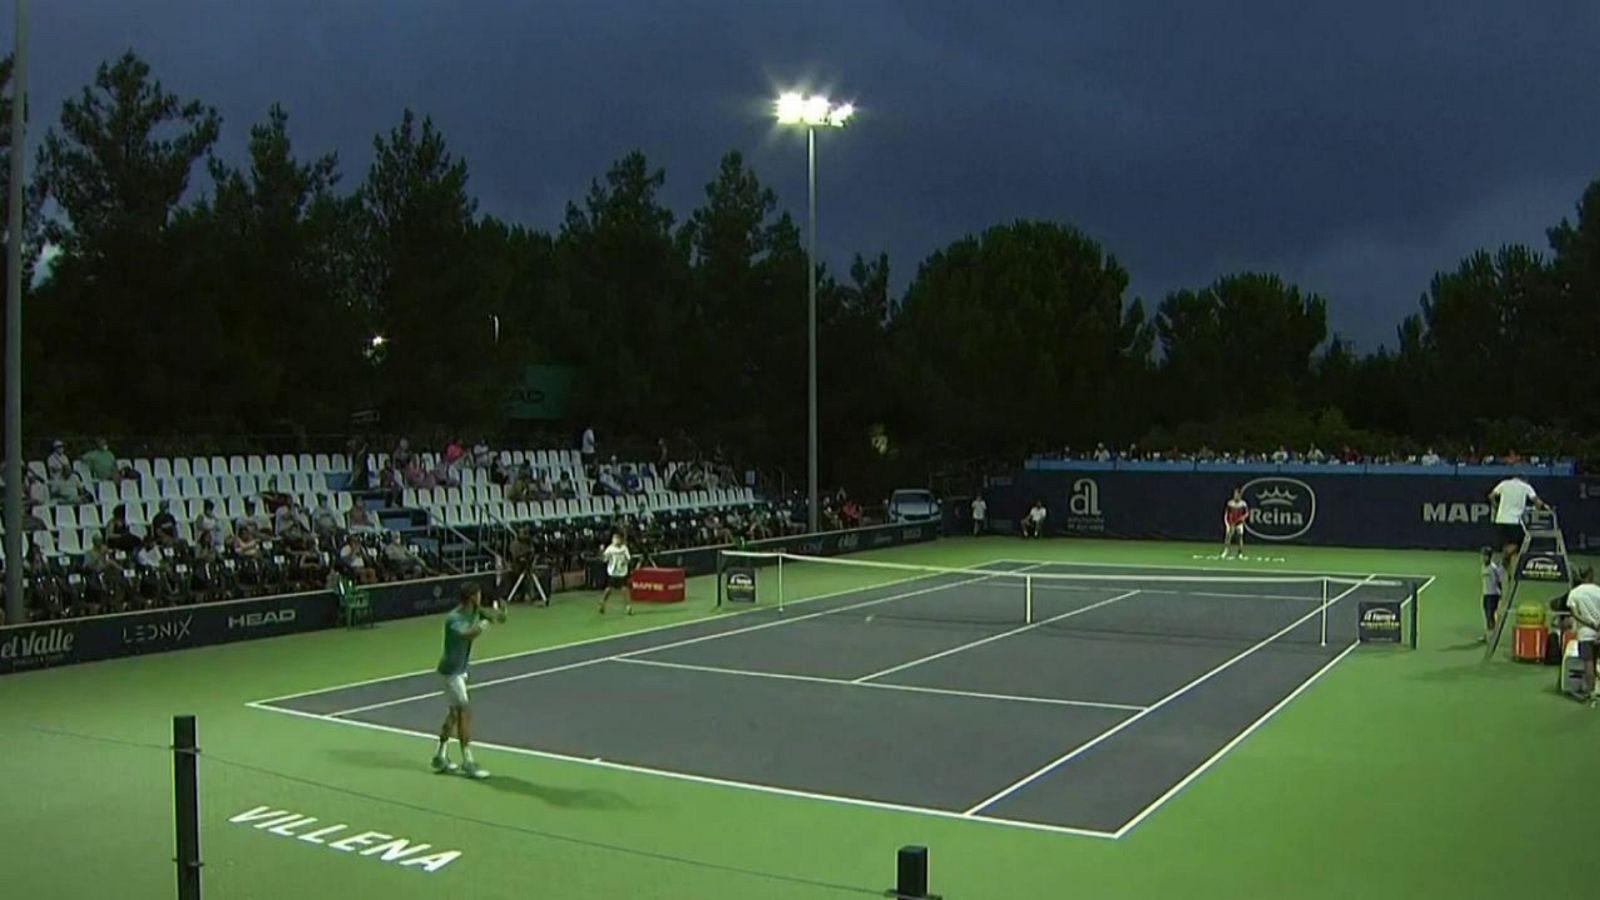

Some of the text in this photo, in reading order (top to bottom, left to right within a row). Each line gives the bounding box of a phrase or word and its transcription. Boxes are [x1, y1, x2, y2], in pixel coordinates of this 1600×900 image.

[1248, 507, 1304, 525] Reina
[228, 609, 296, 629] HEAD
[1, 628, 75, 658] el Valle
[228, 805, 463, 872] VILLENA
